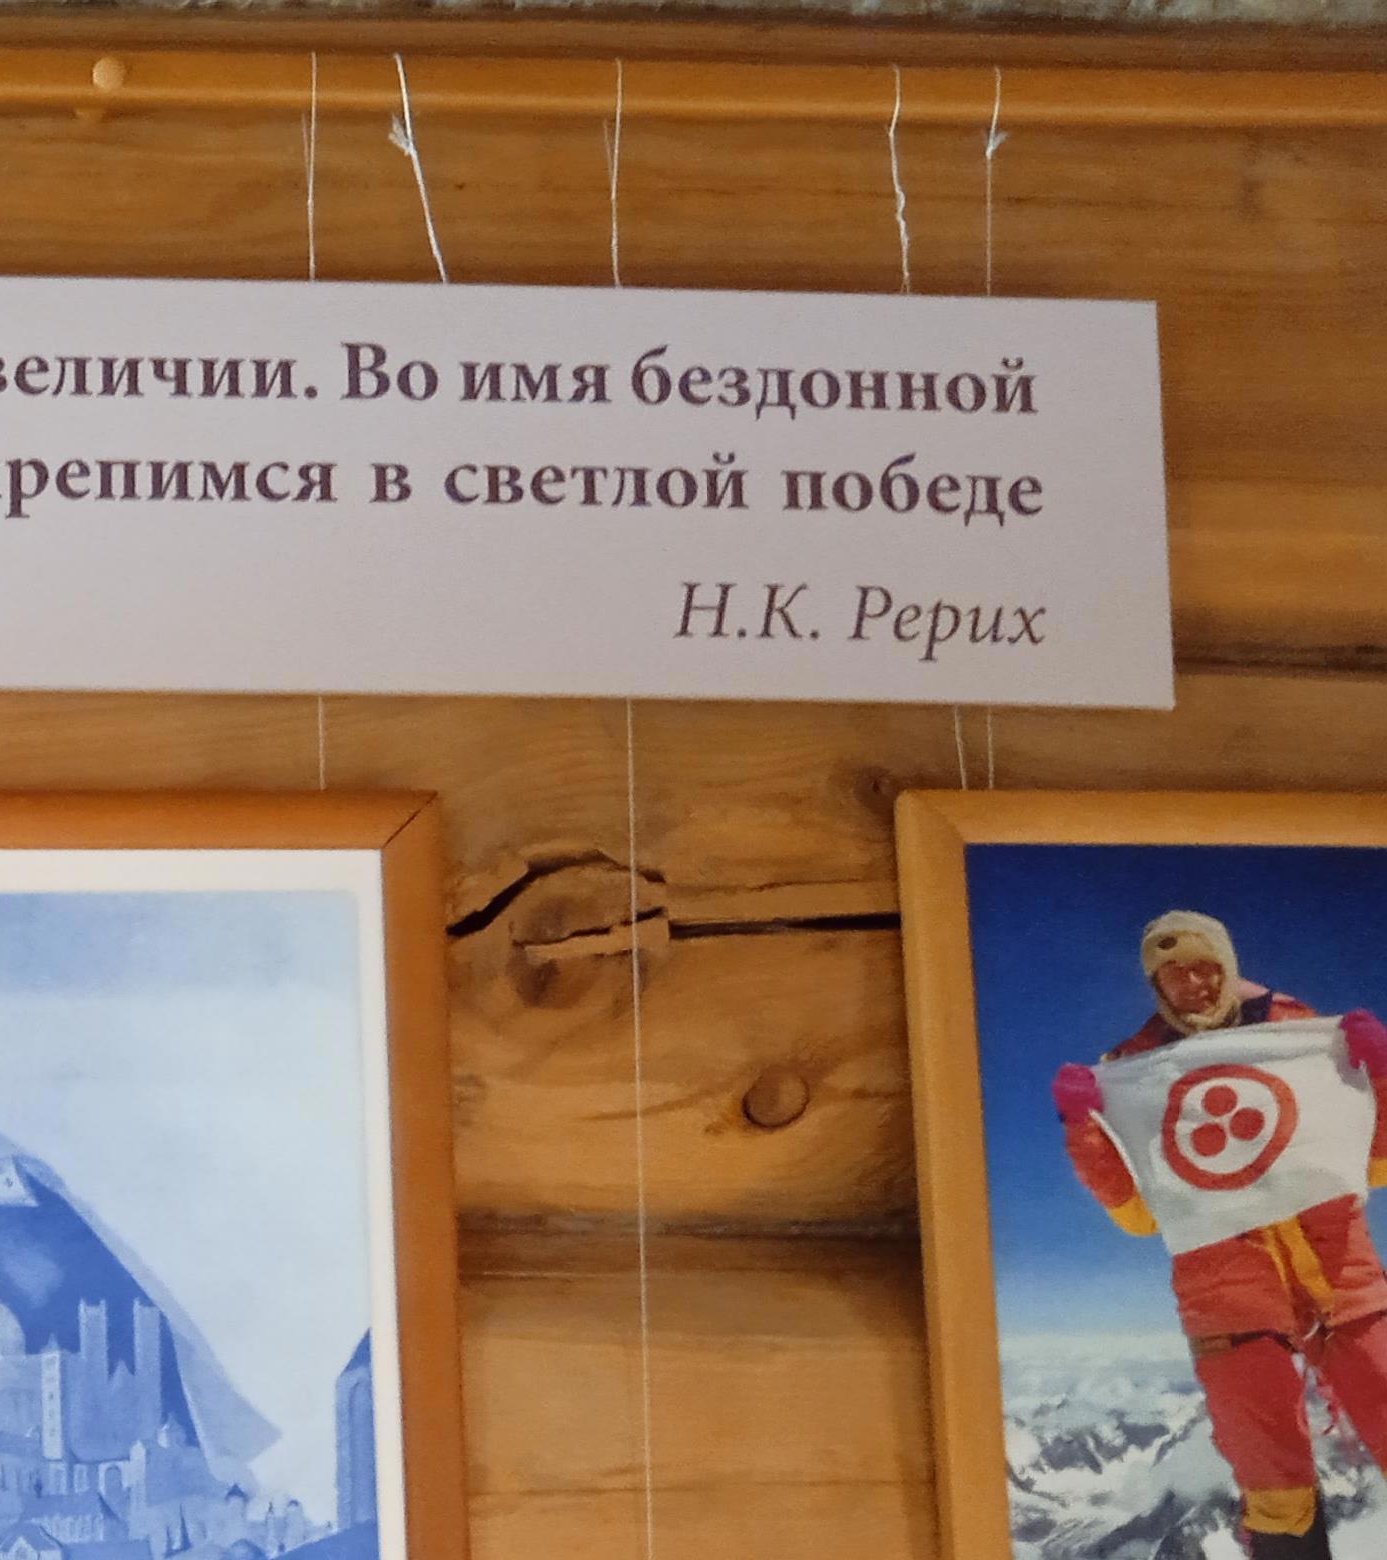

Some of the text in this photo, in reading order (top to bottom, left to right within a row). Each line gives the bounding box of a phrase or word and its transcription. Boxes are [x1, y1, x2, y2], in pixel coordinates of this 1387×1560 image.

[340, 342, 439, 401] Во
[459, 362, 612, 404] имя
[631, 345, 1038, 421] бездонной
[370, 463, 412, 503] в
[444, 452, 749, 509] светлой
[781, 452, 1042, 525] победе
[673, 582, 1046, 661] Н.К. Рерих
